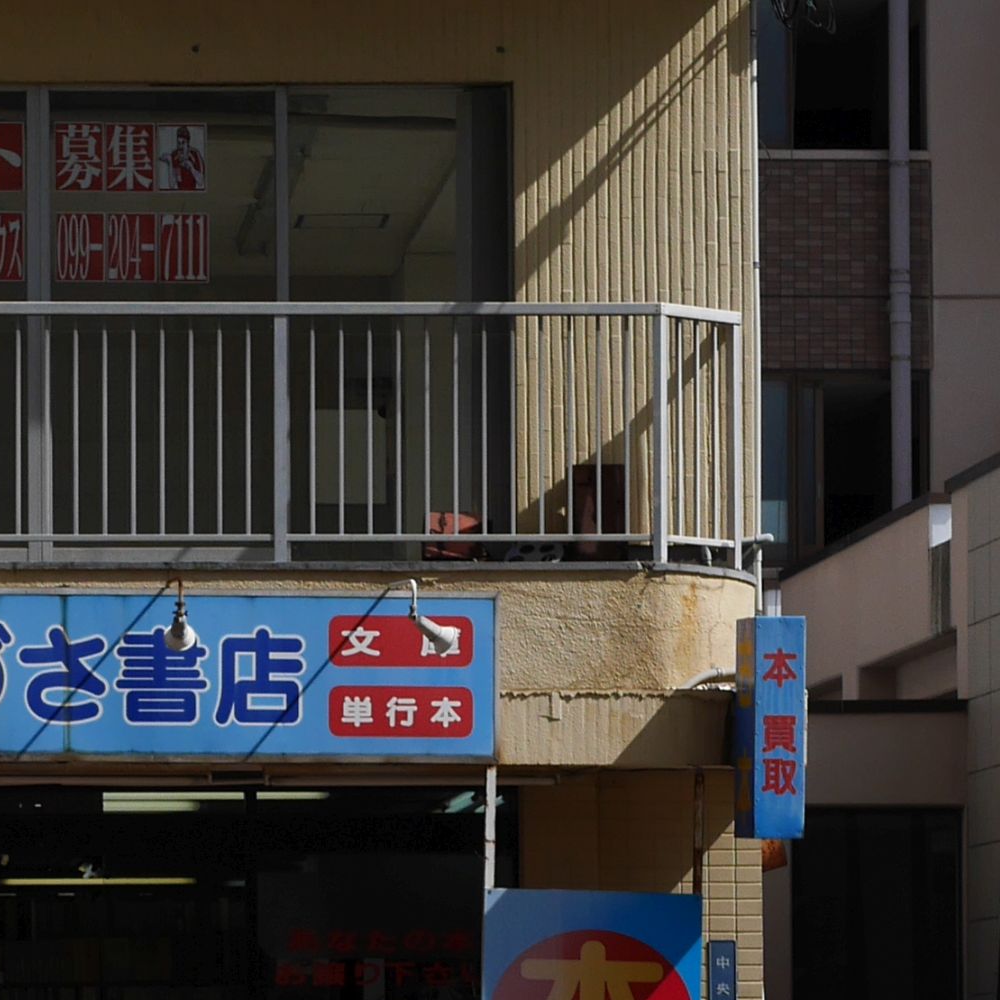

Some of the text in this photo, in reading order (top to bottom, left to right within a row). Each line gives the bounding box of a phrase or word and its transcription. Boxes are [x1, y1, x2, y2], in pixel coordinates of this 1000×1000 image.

[56, 124, 152, 190] 募集
[57, 214, 208, 280] 099-204-7111
[340, 696, 462, 727] 単行本
[763, 648, 797, 796] 本 買取
